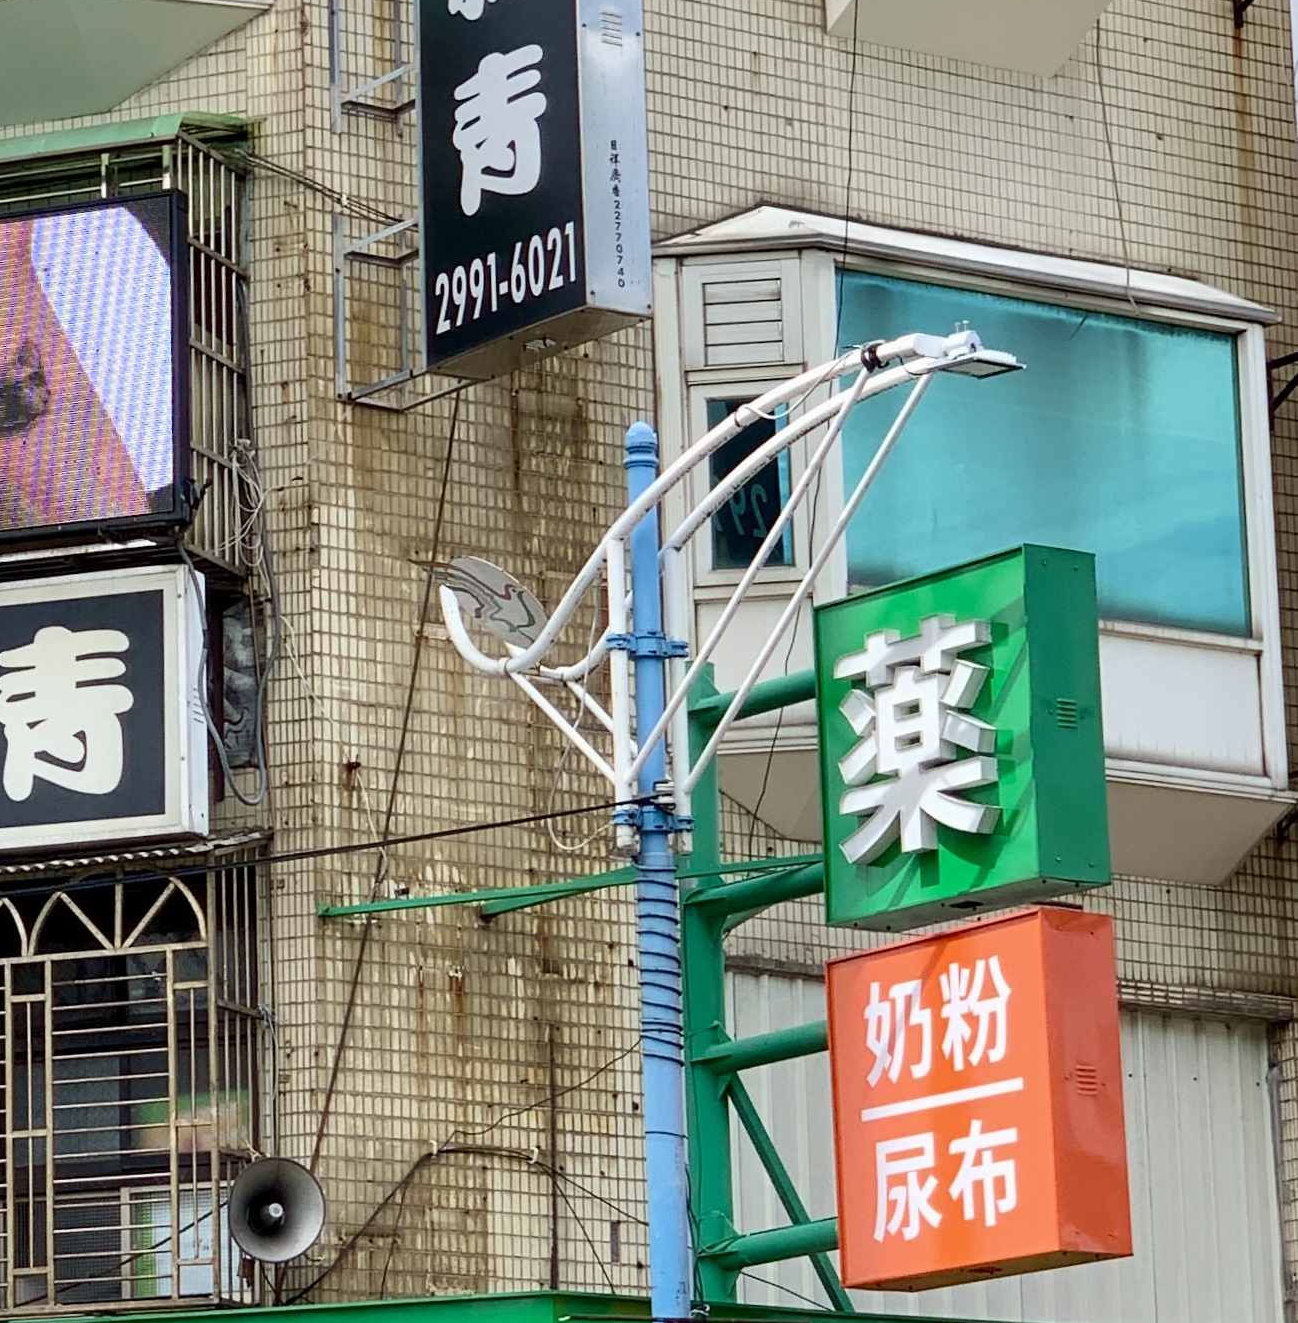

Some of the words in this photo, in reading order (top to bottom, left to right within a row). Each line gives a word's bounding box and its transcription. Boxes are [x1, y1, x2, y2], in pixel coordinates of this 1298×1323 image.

[434, 221, 577, 336] 2991-6021
[864, 955, 1012, 1088] 奶粉
[873, 1119, 1019, 1244] 尿布
